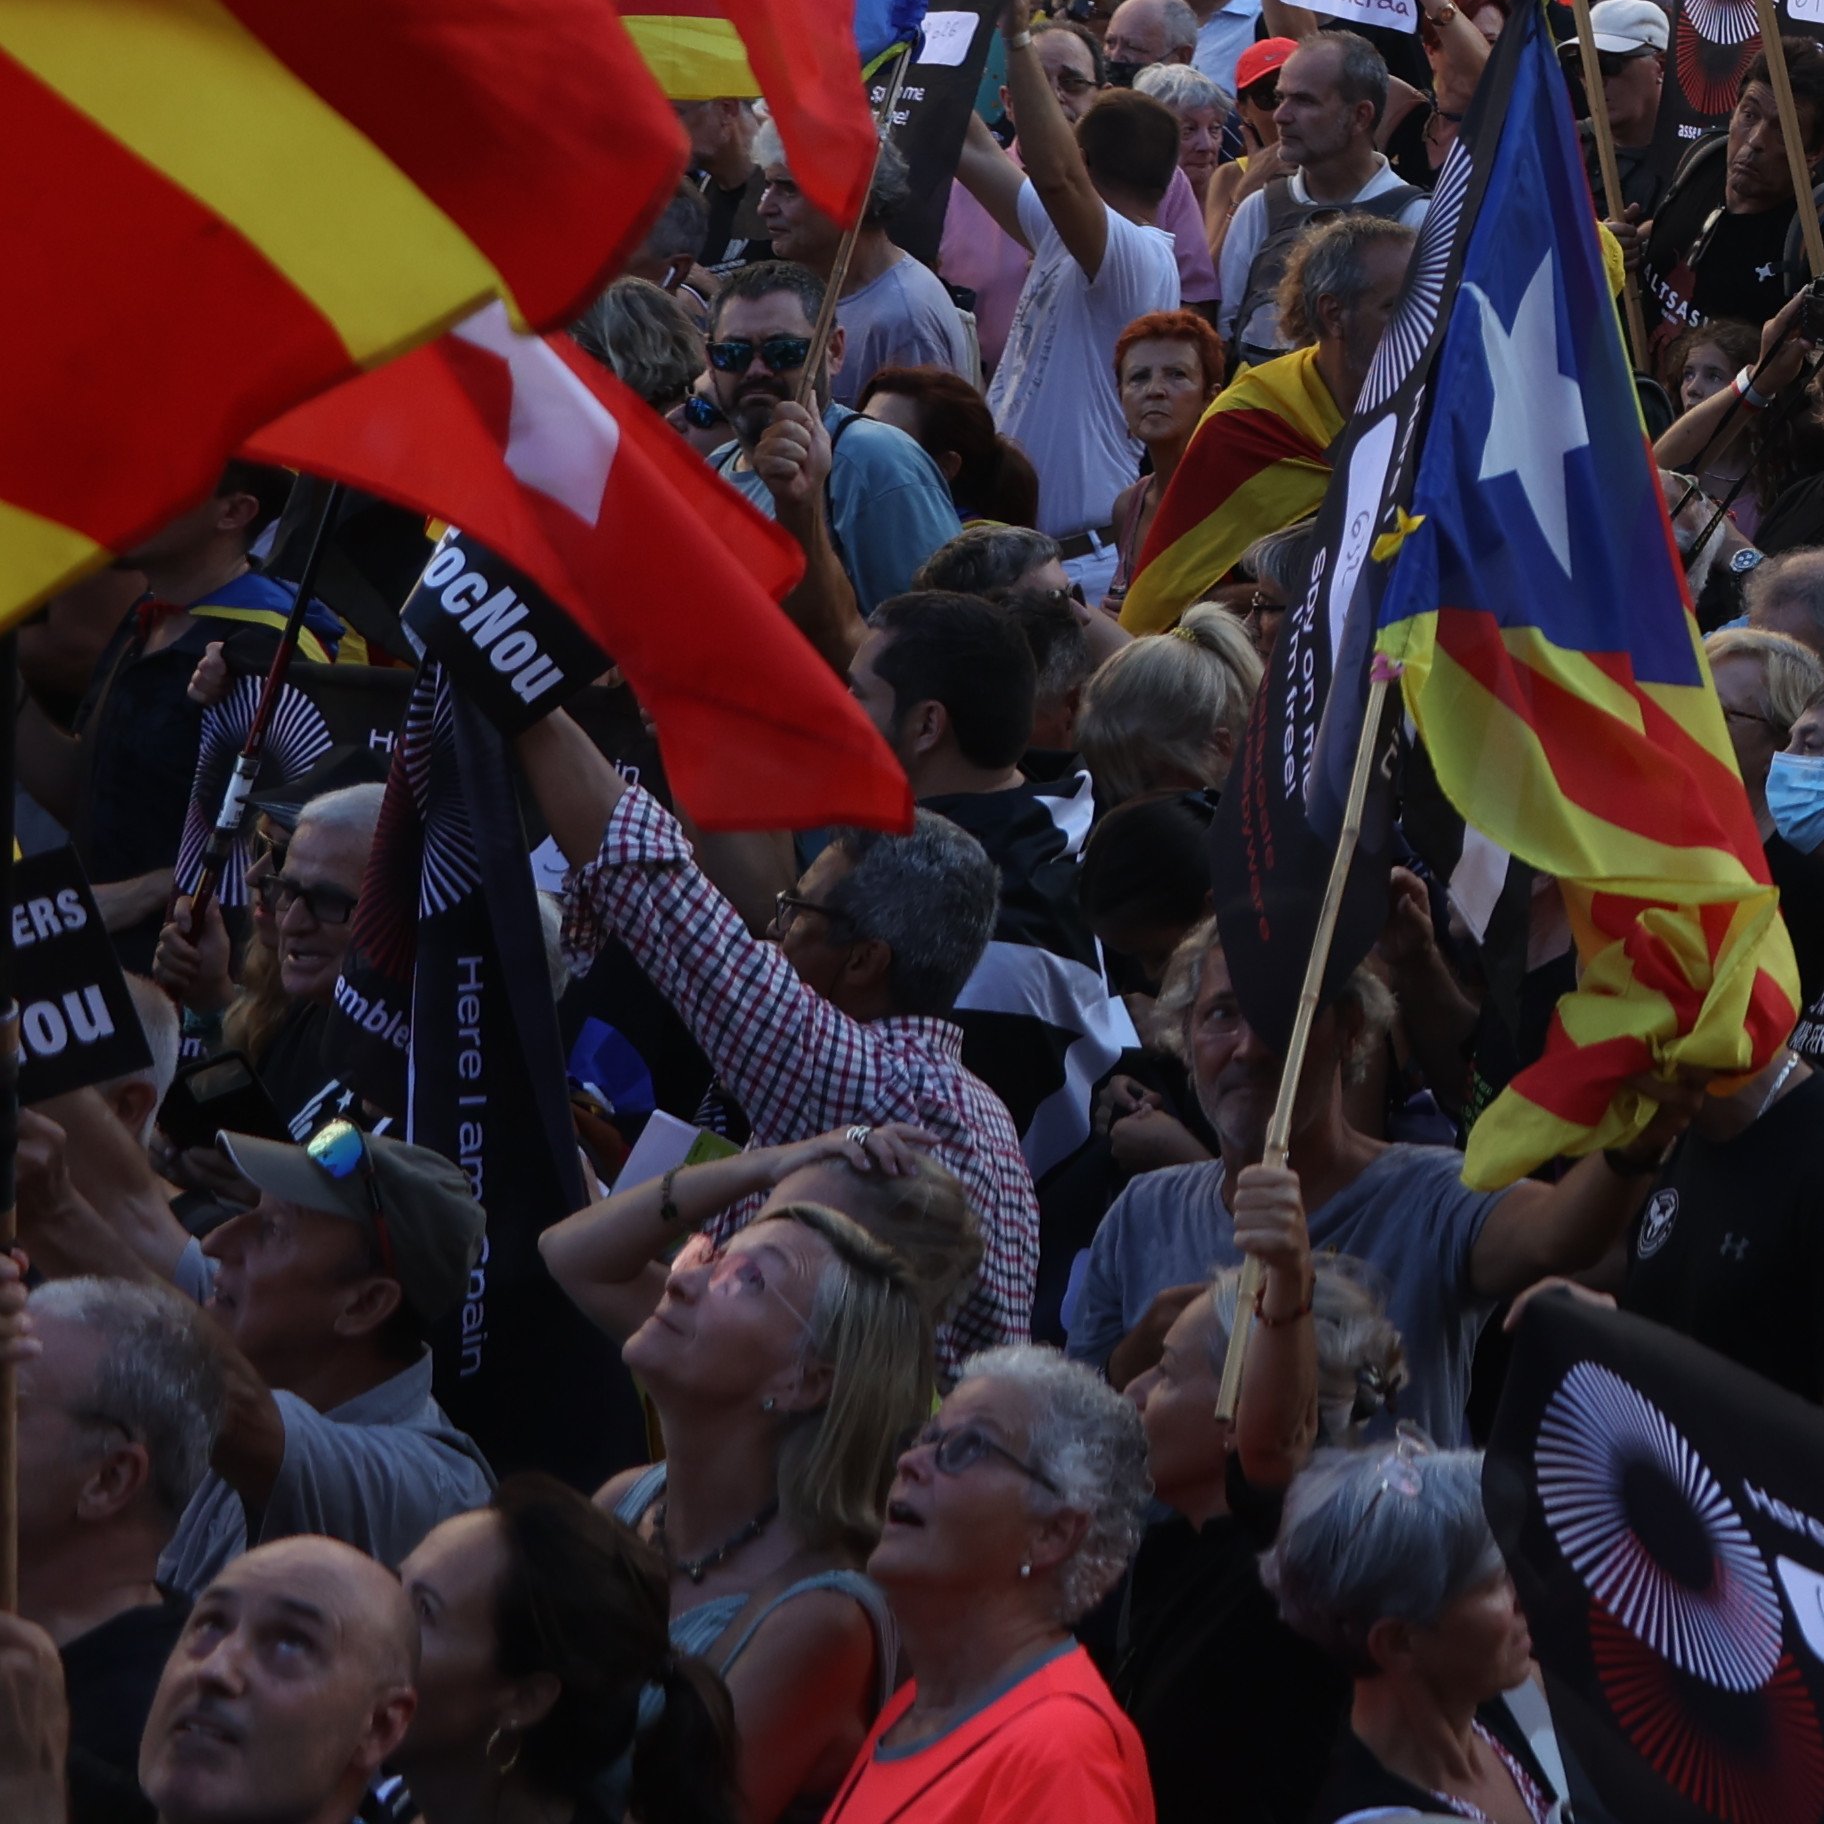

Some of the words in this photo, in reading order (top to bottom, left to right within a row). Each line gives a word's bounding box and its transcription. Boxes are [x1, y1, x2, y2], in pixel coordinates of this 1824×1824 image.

[1302, 546, 1327, 633] Spy
[1302, 647, 1315, 715] on
[457, 956, 485, 1081] Here
[459, 1095, 487, 1106] I
